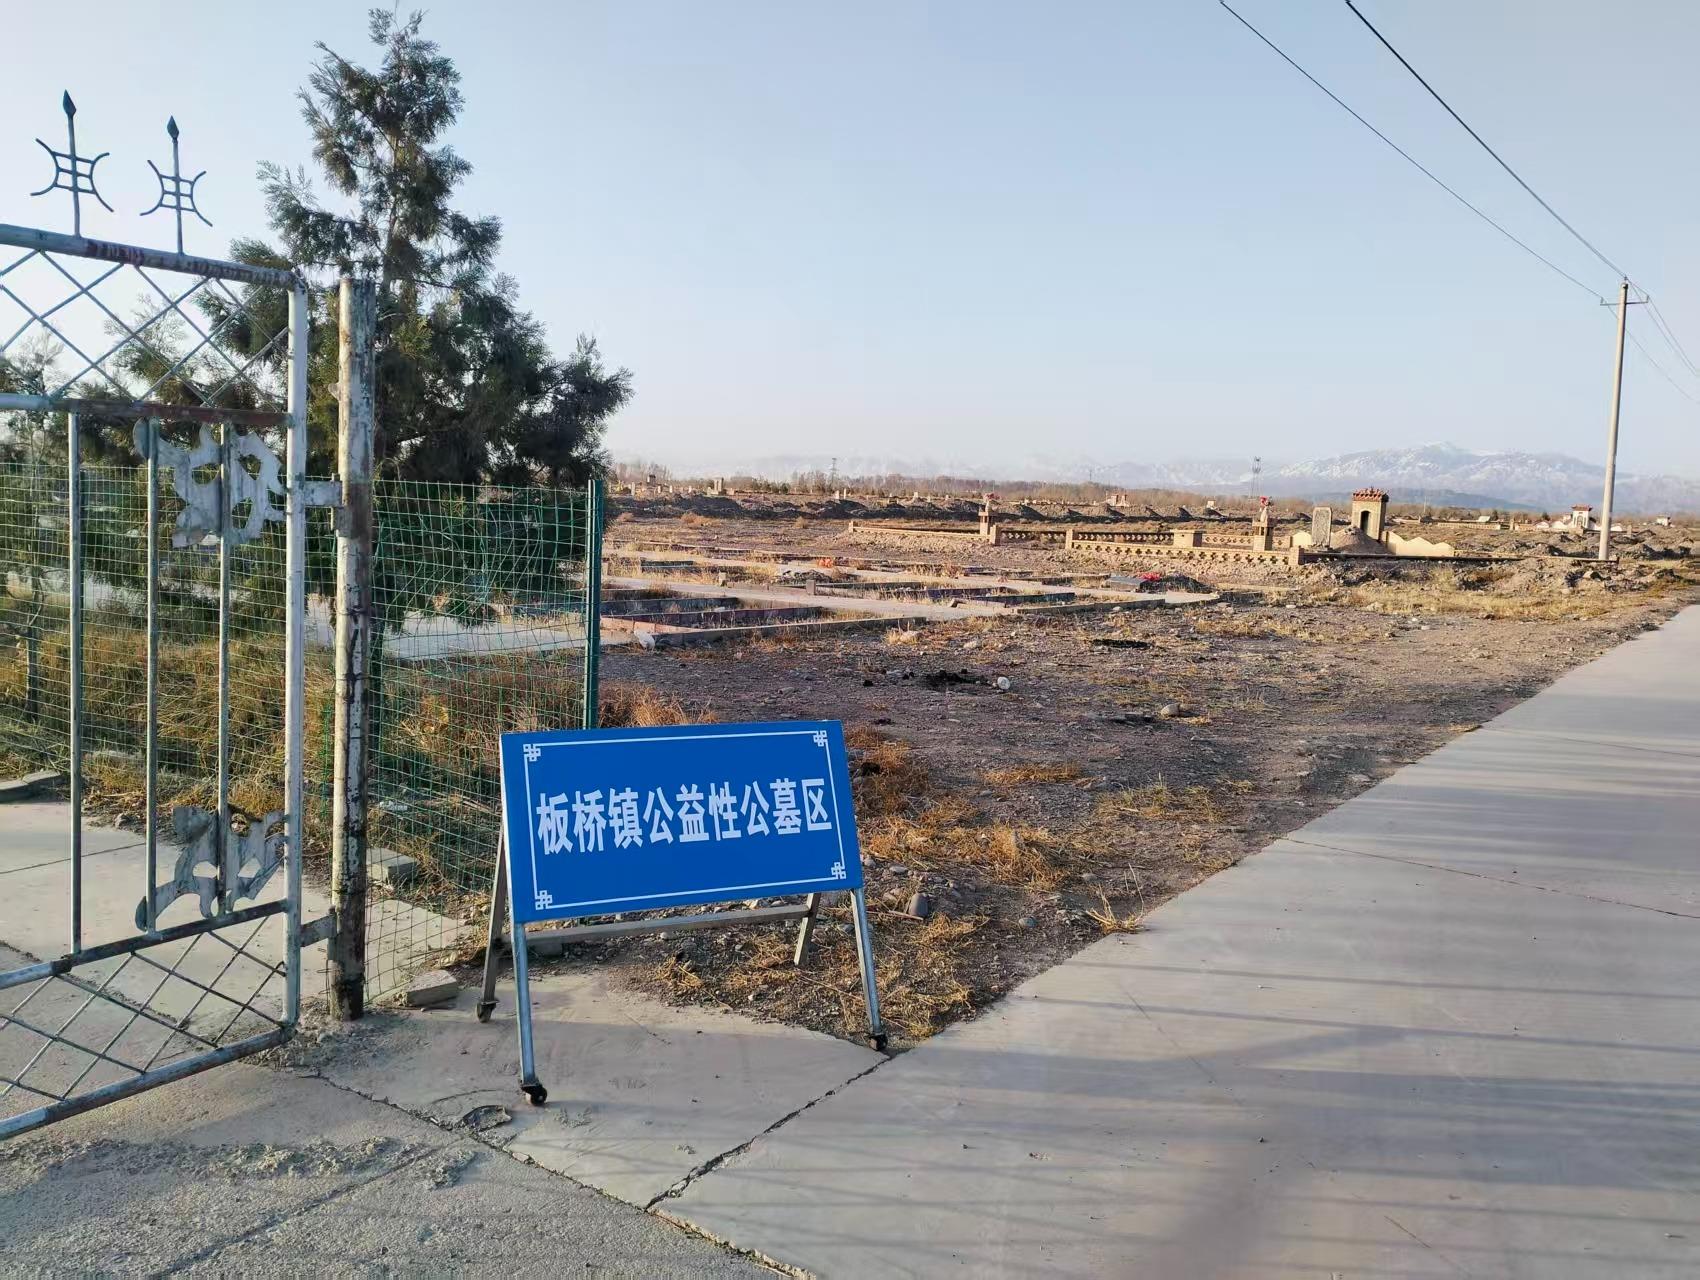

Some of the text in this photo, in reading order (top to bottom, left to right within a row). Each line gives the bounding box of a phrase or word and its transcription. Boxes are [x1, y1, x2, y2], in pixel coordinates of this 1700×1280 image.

[536, 777, 832, 855] 板桥镇公益性公墓区
